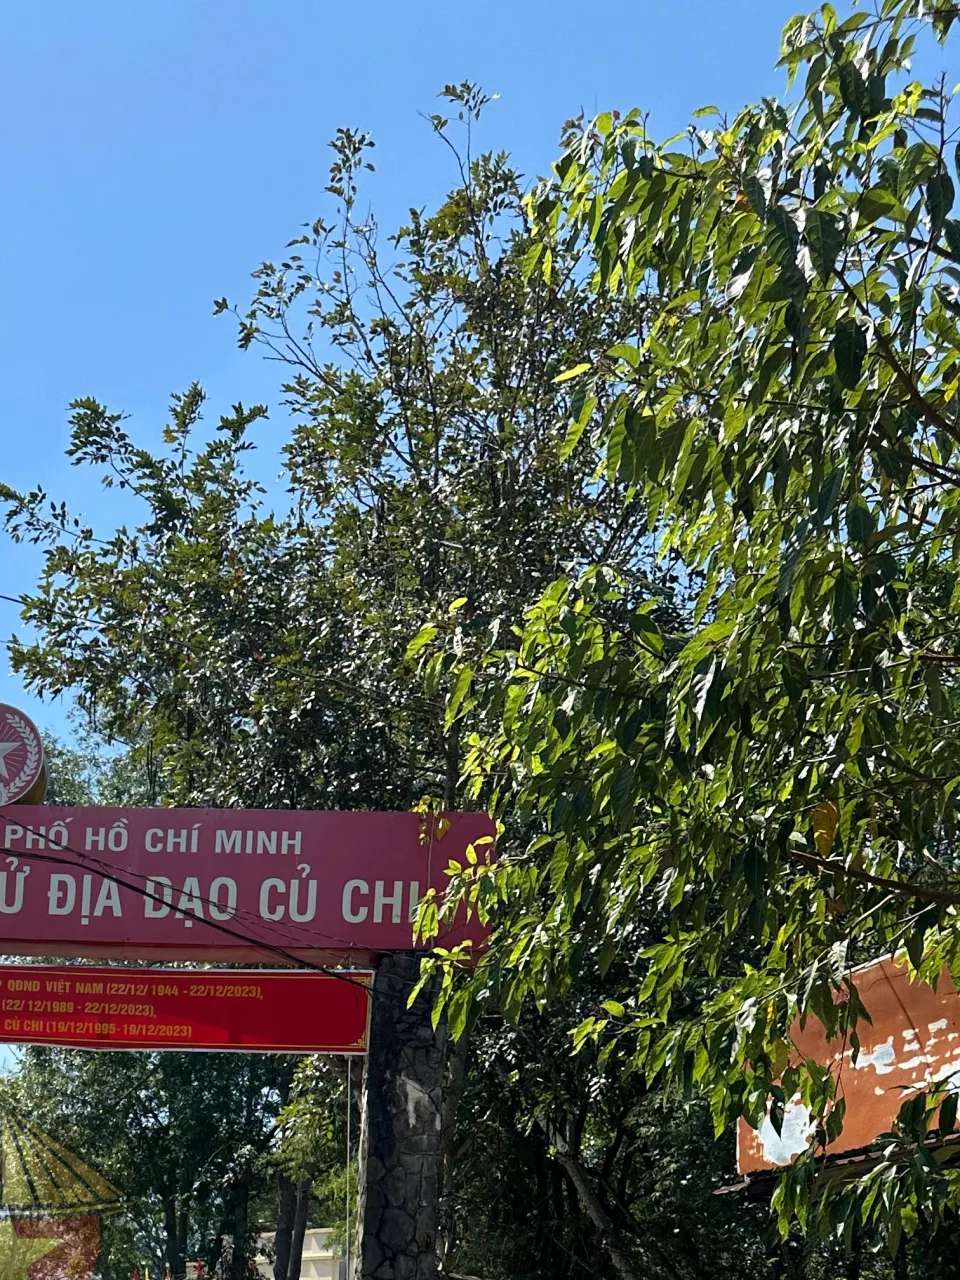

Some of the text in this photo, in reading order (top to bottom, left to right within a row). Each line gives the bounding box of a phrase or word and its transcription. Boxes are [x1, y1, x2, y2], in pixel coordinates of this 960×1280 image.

[4, 817, 74, 850] PHỐ
[85, 818, 129, 852] HỒ
[144, 823, 203, 853] CHÍ
[214, 829, 302, 855] MINH
[47, 873, 123, 925] ĐỊA
[143, 876, 238, 928] ĐẠO
[258, 863, 318, 923] CỦ
[341, 879, 421, 924] CHI
[45, 978, 71, 995] VIỆT
[75, 982, 104, 994] NAM
[4, 1015, 20, 1031] CỦ
[23, 1019, 44, 1032] CHI
